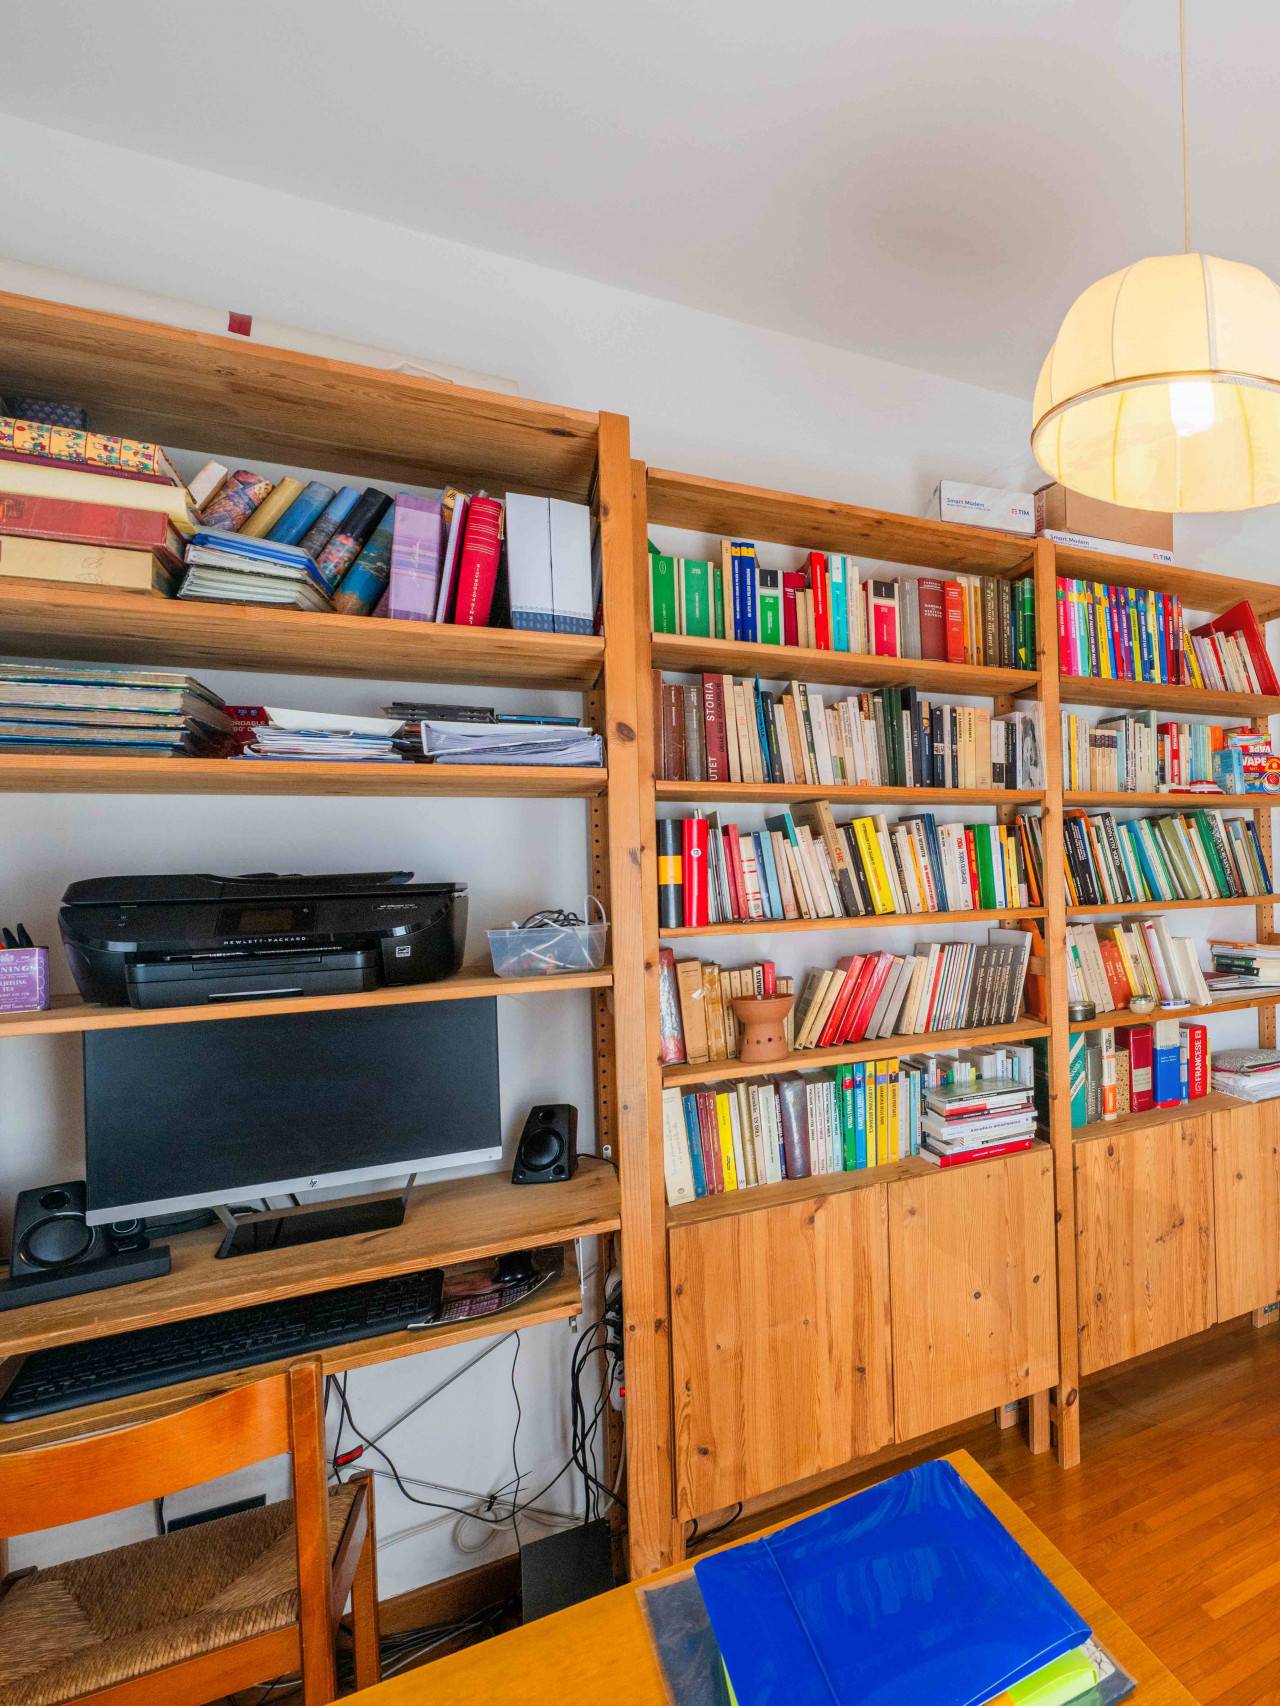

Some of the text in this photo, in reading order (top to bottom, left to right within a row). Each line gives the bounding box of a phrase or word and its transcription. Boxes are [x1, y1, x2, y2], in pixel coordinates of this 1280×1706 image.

[946, 497, 964, 505] Smart
[1069, 537, 1090, 546] Modem
[1159, 554, 1172, 562] TIM
[705, 681, 715, 722] STORIA
[1249, 745, 1272, 754] VAPE
[1242, 756, 1266, 766] VAPE
[708, 756, 718, 781] UTET
